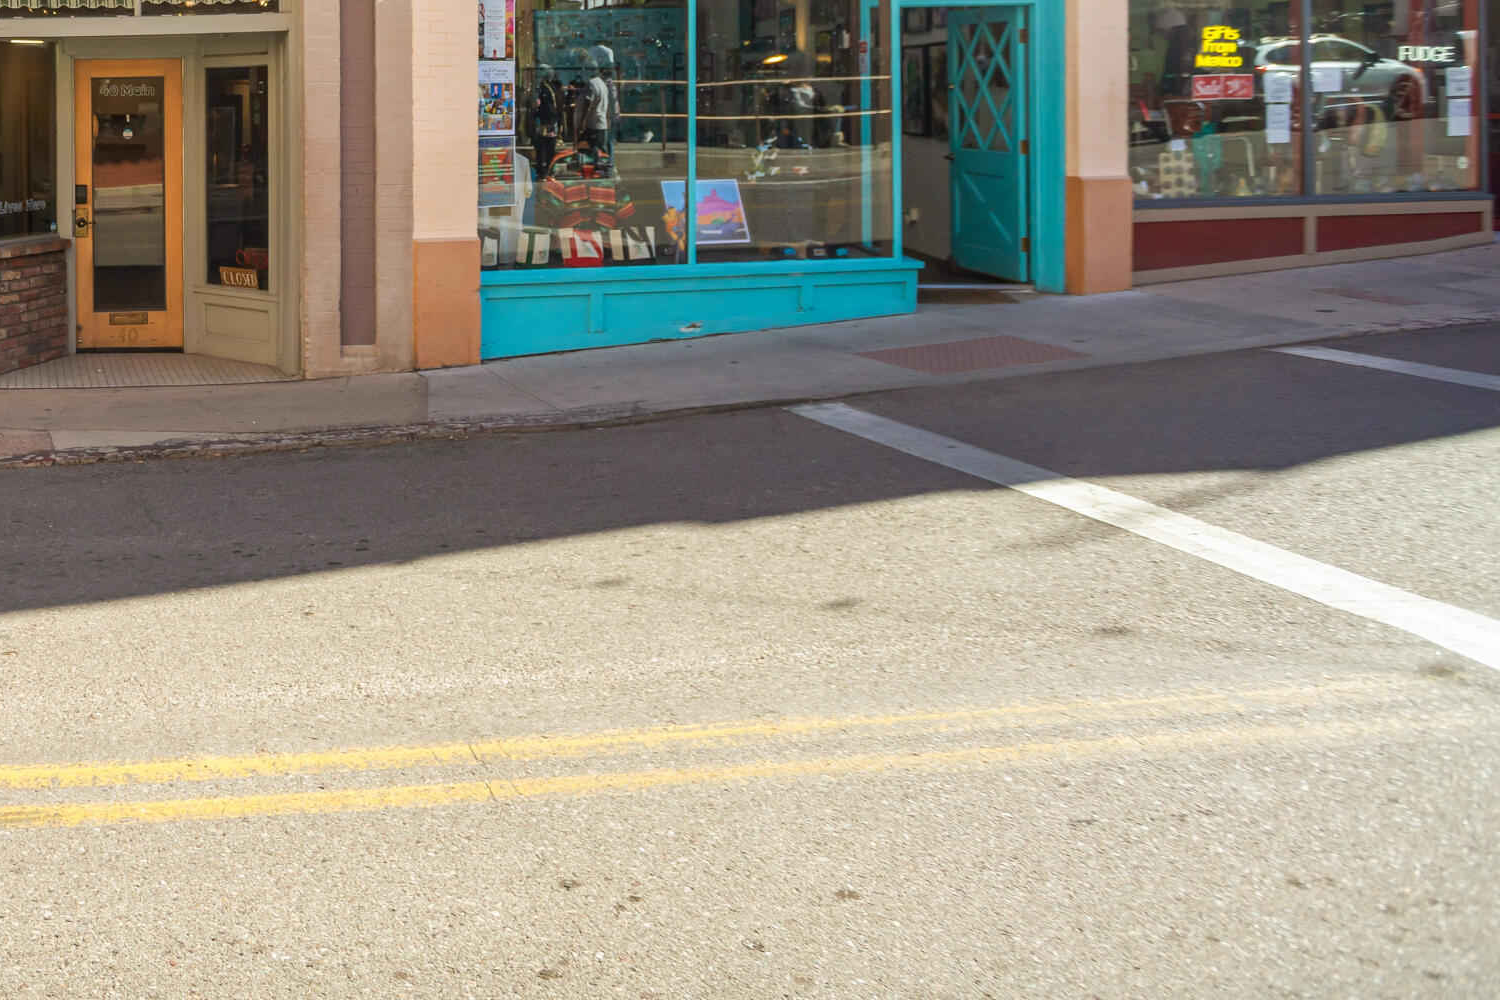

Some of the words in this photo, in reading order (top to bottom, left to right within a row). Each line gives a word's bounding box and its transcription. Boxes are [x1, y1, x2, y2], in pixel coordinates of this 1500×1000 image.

[1398, 46, 1456, 62] FUDGE
[100, 84, 118, 97] 40
[120, 83, 155, 97] Main
[26, 198, 46, 211] Here
[223, 270, 258, 287] CLOSED
